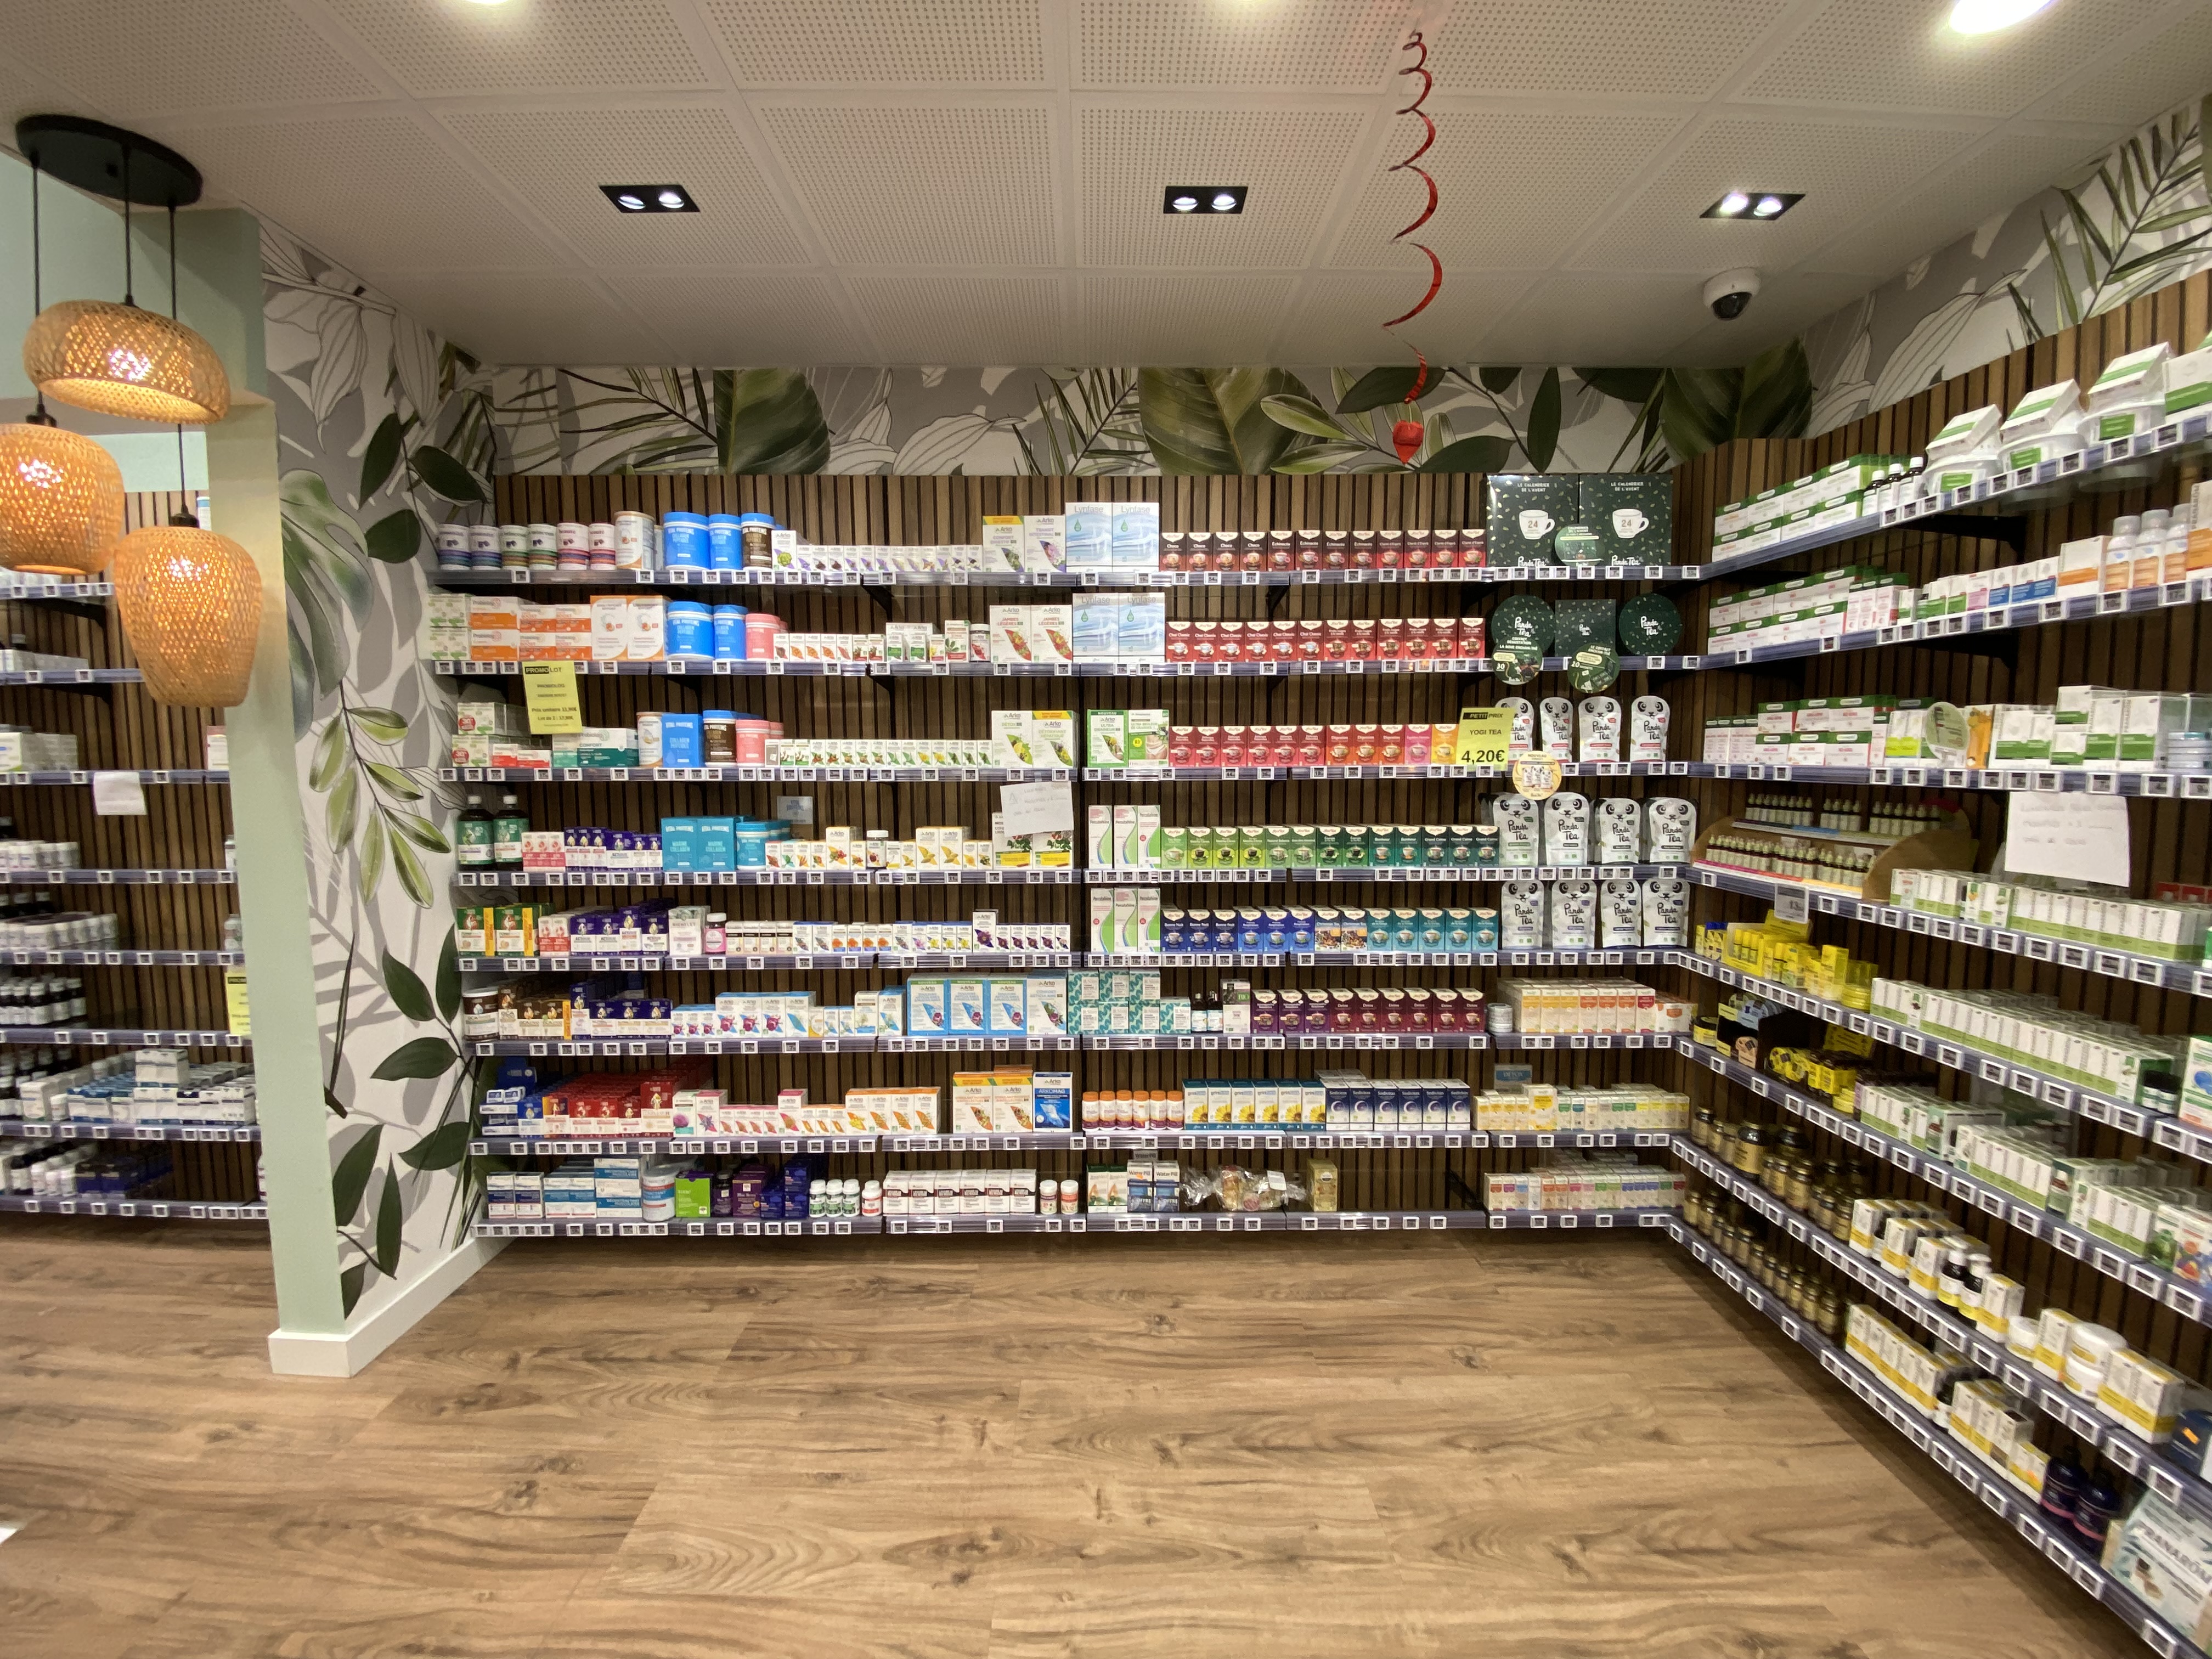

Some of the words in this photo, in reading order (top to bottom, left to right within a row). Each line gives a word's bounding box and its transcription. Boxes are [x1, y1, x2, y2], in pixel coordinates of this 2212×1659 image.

[1075, 506, 1103, 514] Lynfase
[1121, 506, 1150, 514] Lynfase
[1641, 616, 1658, 628] Panda
[1593, 721, 1611, 732] Panda
[1644, 720, 1660, 732] Panda
[1508, 820, 1528, 832] Panda
[1558, 820, 1579, 832] Panda
[1612, 823, 1630, 834] Panda
[1662, 823, 1683, 834] Panda
[1513, 831, 1528, 840] Tea
[1562, 831, 1579, 840] Tea
[1515, 904, 1534, 916] Panda
[1564, 903, 1584, 915] Panda
[1614, 903, 1633, 915] Panda
[1657, 902, 1677, 915] Panda
[1519, 916, 1534, 924] Tea
[1570, 915, 1584, 924] Tea
[1619, 915, 1633, 924] Tea
[1662, 914, 1677, 923] Tea
